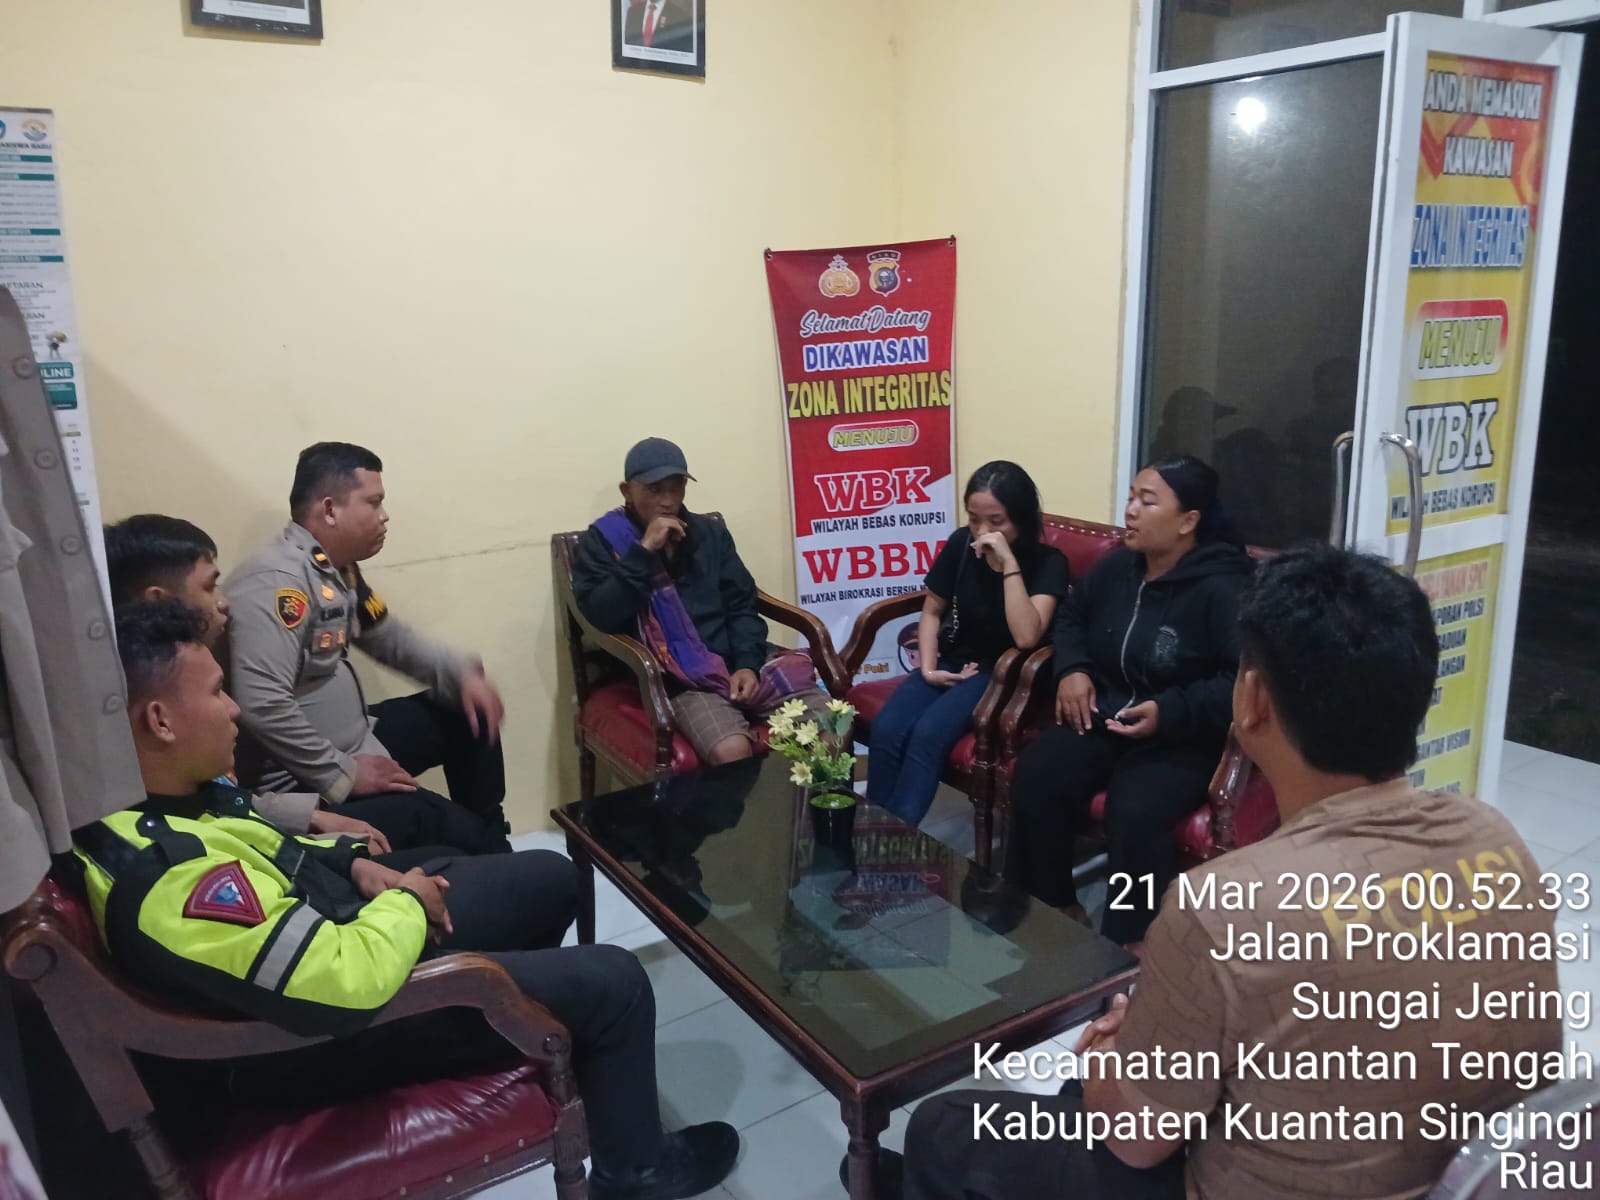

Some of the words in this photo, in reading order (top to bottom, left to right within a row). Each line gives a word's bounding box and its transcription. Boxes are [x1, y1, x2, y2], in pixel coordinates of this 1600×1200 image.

[1423, 69, 1466, 112] ANDA
[1471, 76, 1543, 120] MEMASUKI
[1443, 136, 1515, 179] KAWASAN
[1411, 203, 1449, 267] ZONA
[1450, 204, 1530, 268] INTEGRITAS
[800, 308, 868, 338] Selamat
[867, 304, 931, 332] Datang
[804, 337, 928, 371] DIKAWASAN
[1419, 317, 1502, 370] MENUJU
[41, 367, 72, 378] LINE
[787, 380, 840, 418] ZONA
[844, 369, 952, 414] INTEGRITAS
[833, 425, 914, 449] MENUJU
[1405, 398, 1499, 478] WBK
[815, 466, 932, 513] WBK
[813, 518, 859, 534] WILAYAH
[862, 514, 896, 530] BEBAS
[899, 511, 946, 527] KORUPSI
[802, 540, 948, 584] WBBM
[800, 591, 837, 605] WILAYAH
[838, 586, 885, 602] BIROKRASI
[886, 583, 918, 598] BERSIH
